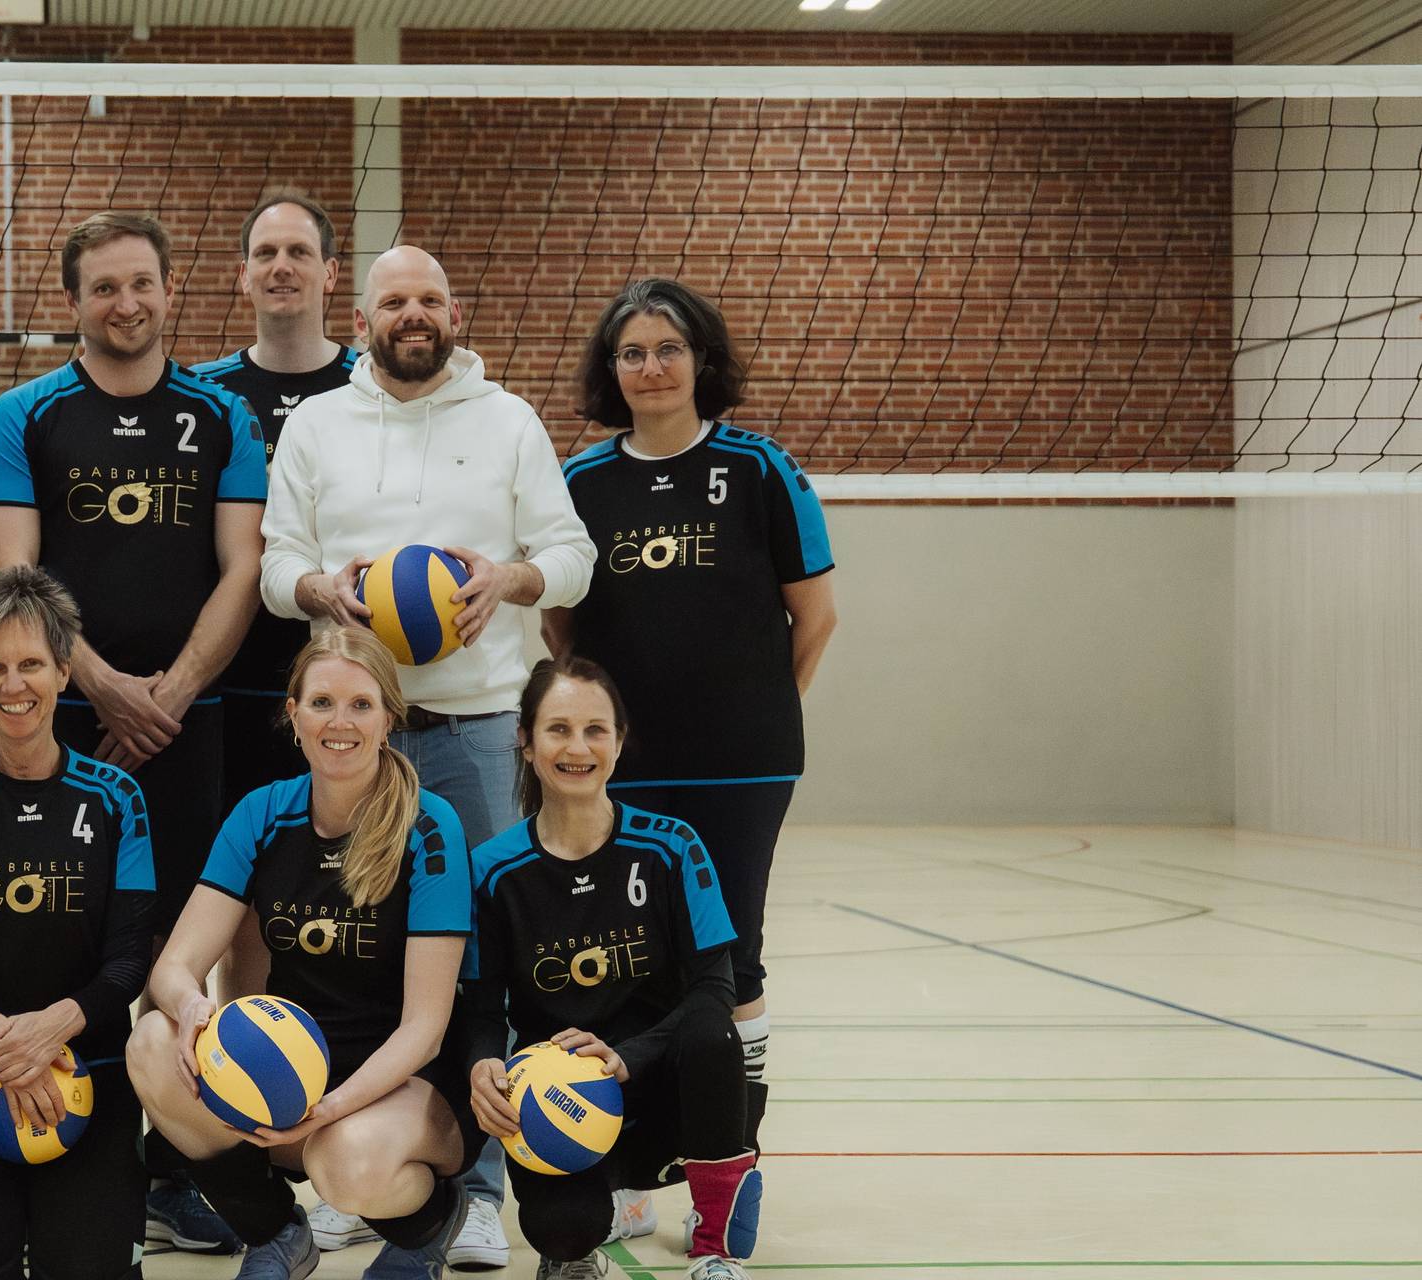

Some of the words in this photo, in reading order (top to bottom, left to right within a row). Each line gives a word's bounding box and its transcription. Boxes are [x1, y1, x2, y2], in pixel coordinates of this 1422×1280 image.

[273, 406, 295, 417] eri
[113, 426, 147, 437] erima
[175, 412, 200, 454] 2
[68, 466, 200, 482] GABRIELE
[707, 467, 729, 505] 5
[613, 522, 718, 542] GABRIELE
[72, 802, 94, 845] 4
[627, 861, 648, 908] 6
[272, 900, 379, 920] GABRIELE
[535, 925, 646, 955] GABRIELE
